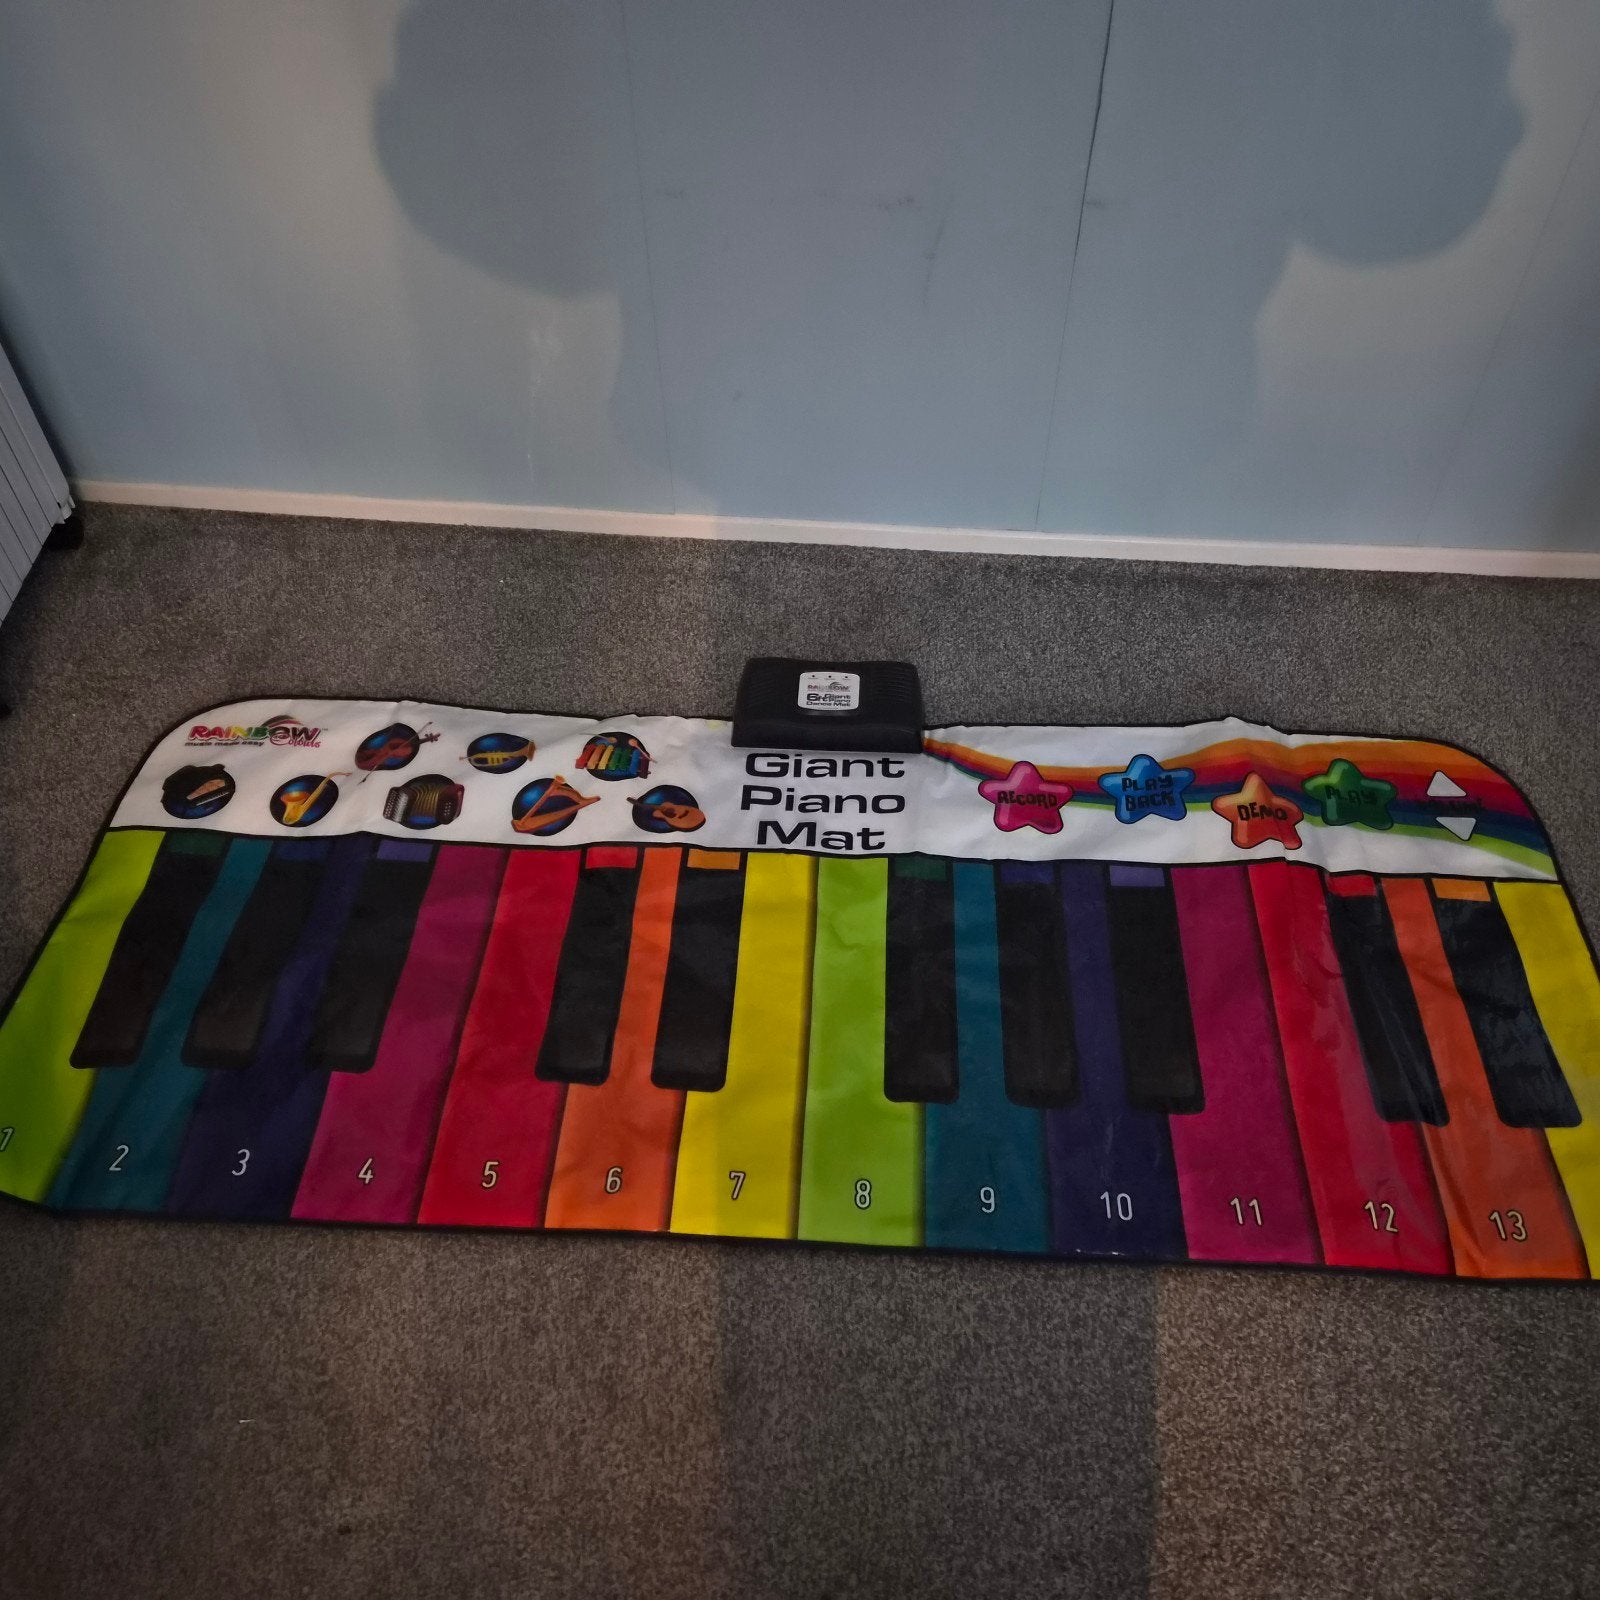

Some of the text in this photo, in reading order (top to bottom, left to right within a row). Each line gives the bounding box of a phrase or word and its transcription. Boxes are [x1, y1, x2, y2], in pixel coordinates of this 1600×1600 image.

[188, 724, 321, 741] RAINBOW
[745, 752, 905, 778] Giant
[1121, 774, 1174, 792] PLAY
[740, 784, 906, 814] Piano
[997, 790, 1059, 810] RECORD
[1125, 792, 1177, 812] BACK
[1236, 801, 1290, 821] DEMO
[757, 820, 886, 851] Mat
[0, 1127, 14, 1151] 1
[108, 1144, 130, 1172] 2
[231, 1148, 251, 1176] 3
[357, 1158, 375, 1184] 4
[481, 1160, 500, 1189] 5
[604, 1166, 623, 1194] 6
[728, 1170, 746, 1201] 7
[854, 1178, 872, 1210] 8
[979, 1186, 997, 1214] 9
[1099, 1190, 1134, 1221] 10
[1229, 1196, 1263, 1227] 11
[1363, 1200, 1400, 1234] 12
[1488, 1209, 1529, 1242] 13
